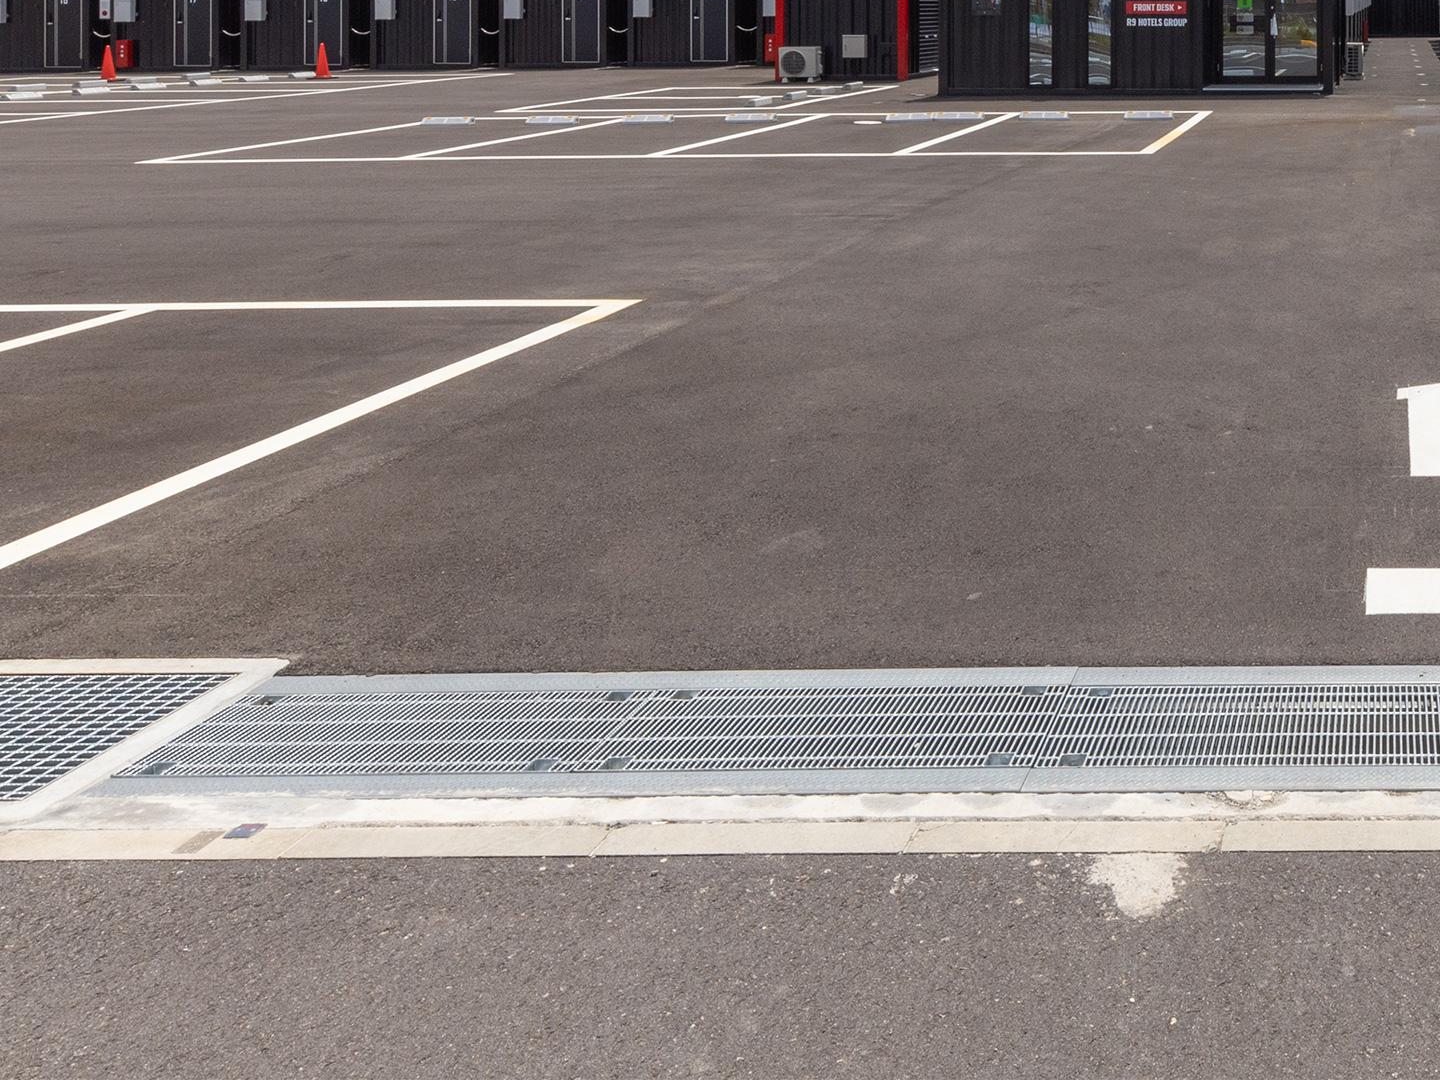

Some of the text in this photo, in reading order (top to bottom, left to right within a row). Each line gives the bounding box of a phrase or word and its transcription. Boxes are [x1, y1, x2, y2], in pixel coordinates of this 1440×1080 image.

[1133, 3, 1175, 12] FRONT DESK
[1126, 18, 1188, 27] R9 HOTELS GROUP
